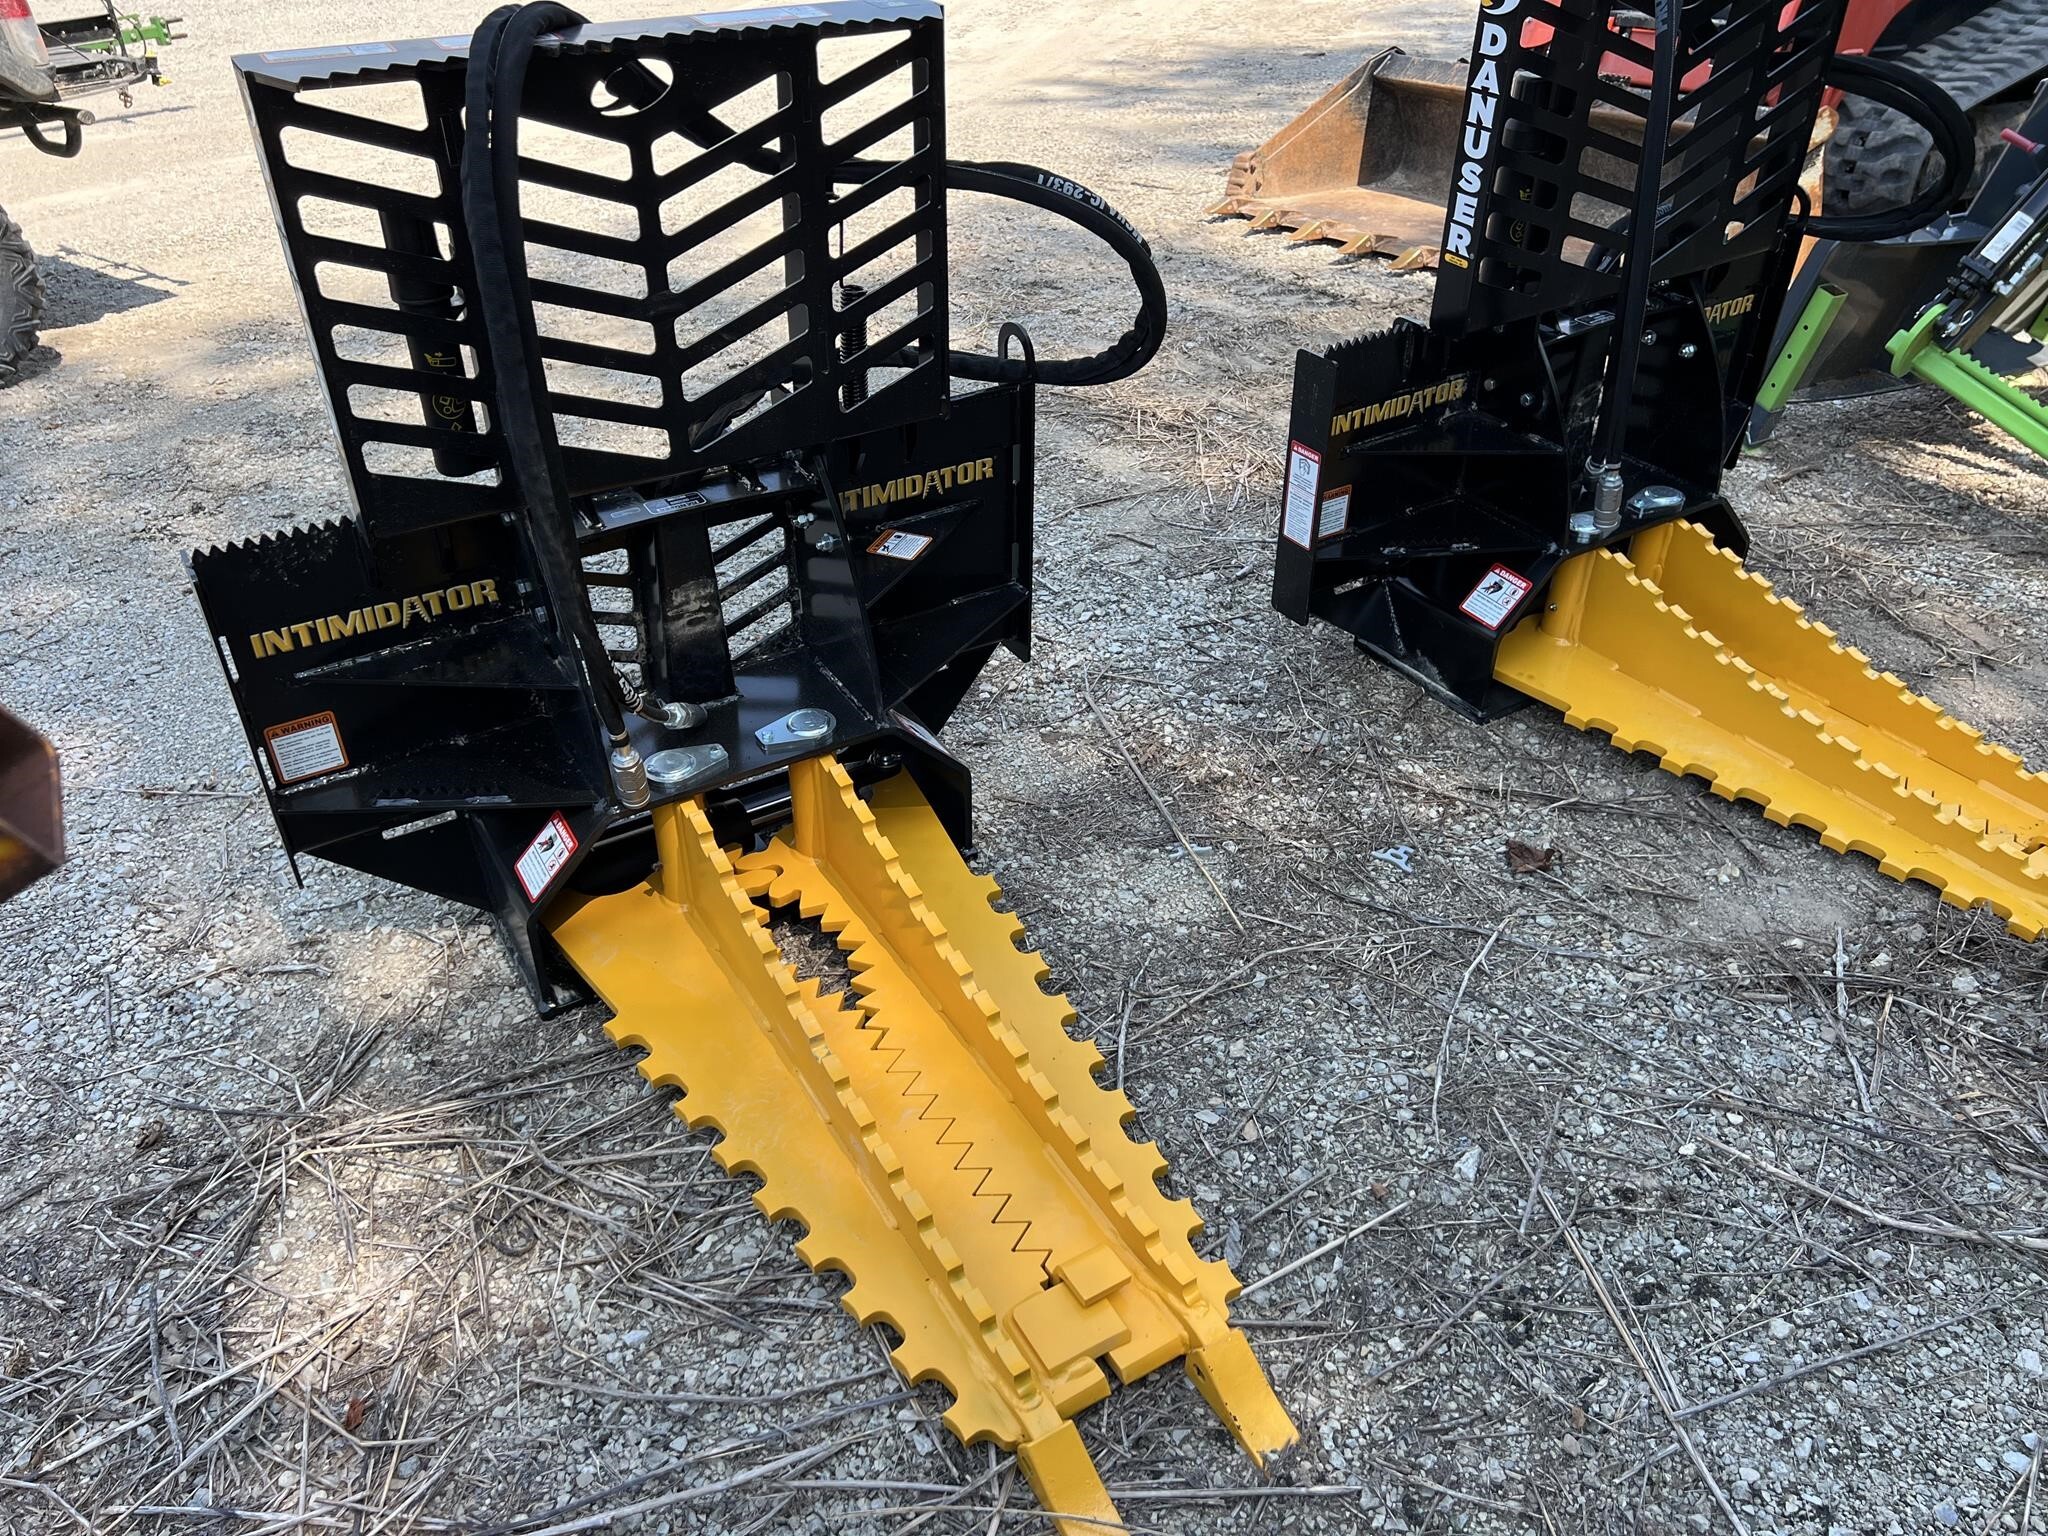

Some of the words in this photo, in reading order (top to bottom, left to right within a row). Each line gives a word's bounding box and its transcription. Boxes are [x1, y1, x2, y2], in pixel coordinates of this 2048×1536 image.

[1446, 21, 1508, 259] DANUSER
[1330, 378, 1468, 437] INTIMIDATOR
[1499, 569, 1527, 589] DANGER
[249, 578, 500, 659] INTIMIDATOR
[281, 715, 330, 735] WARNING
